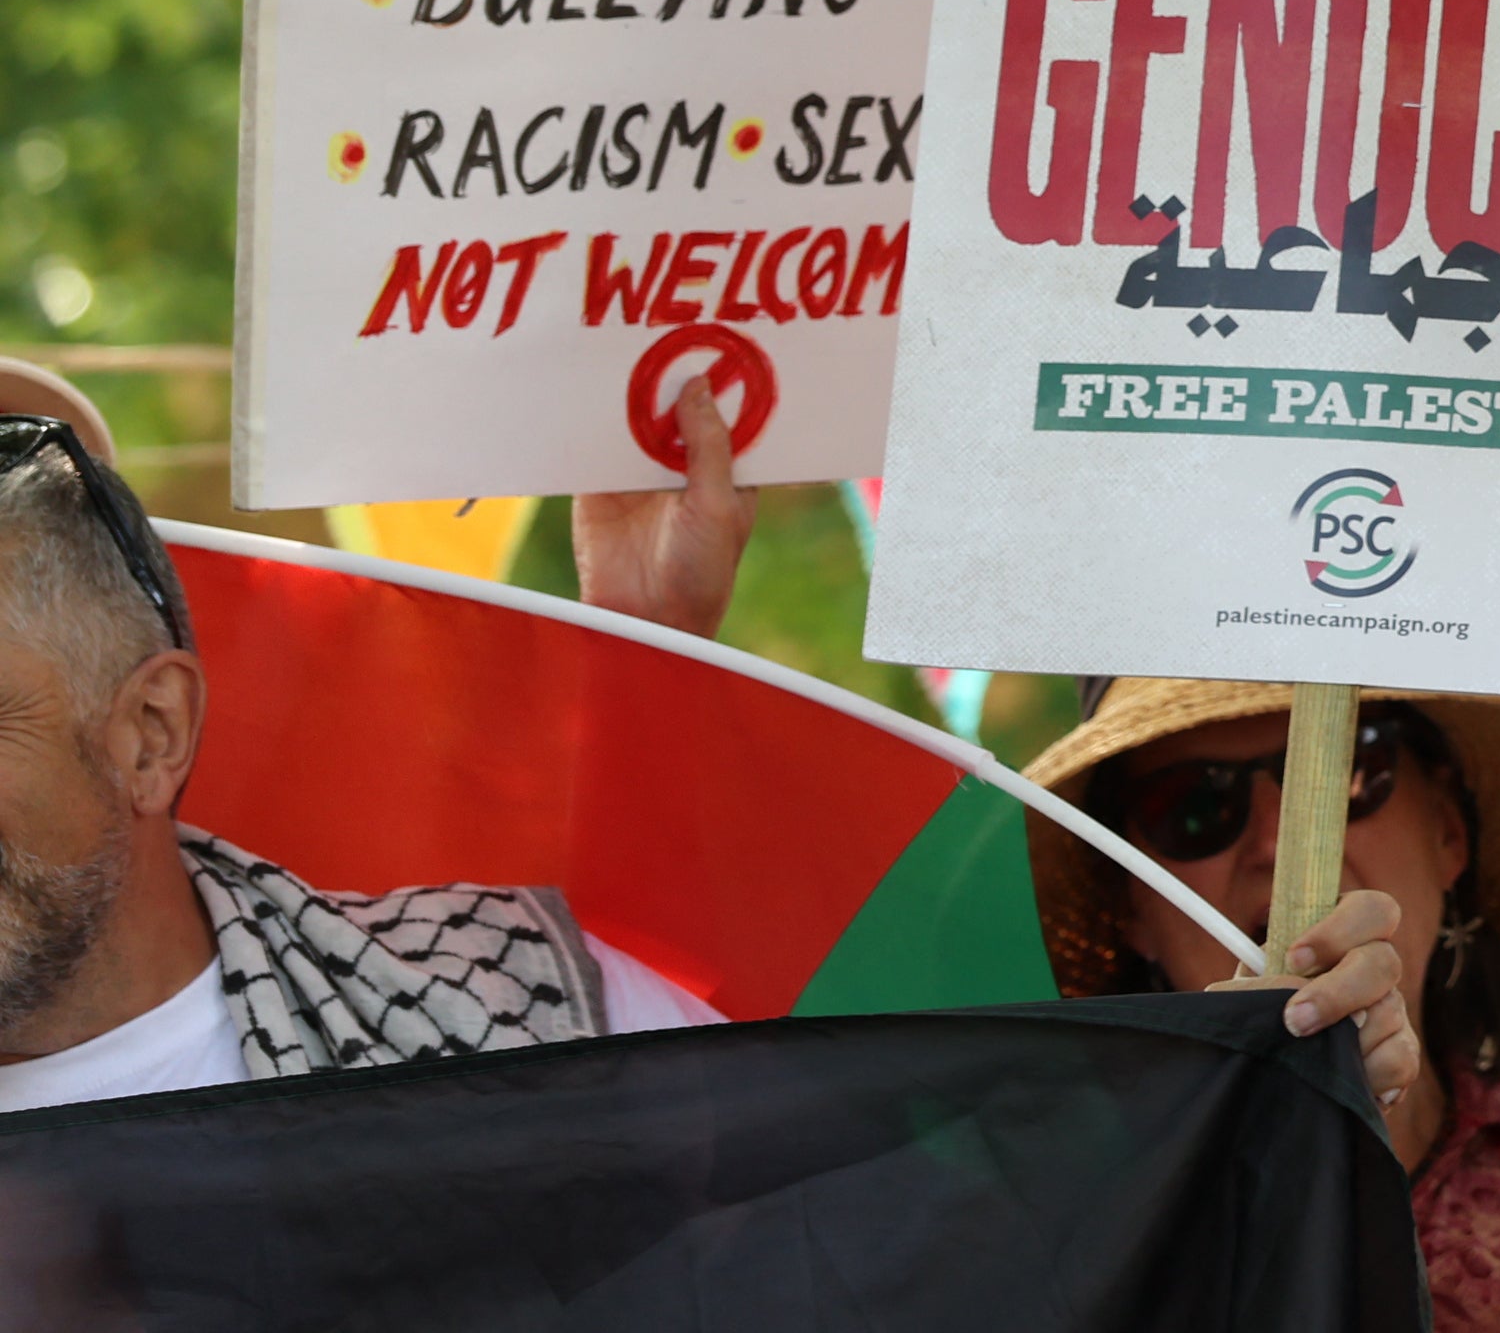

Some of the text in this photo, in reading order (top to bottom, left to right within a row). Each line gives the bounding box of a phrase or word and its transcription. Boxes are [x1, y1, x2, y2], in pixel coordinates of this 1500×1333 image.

[380, 101, 727, 200] RACISM
[358, 229, 568, 340] NOT
[1057, 372, 1248, 423] FREE
[1311, 510, 1396, 560] PSC
[1215, 606, 1470, 641] palestinecampaign.org
